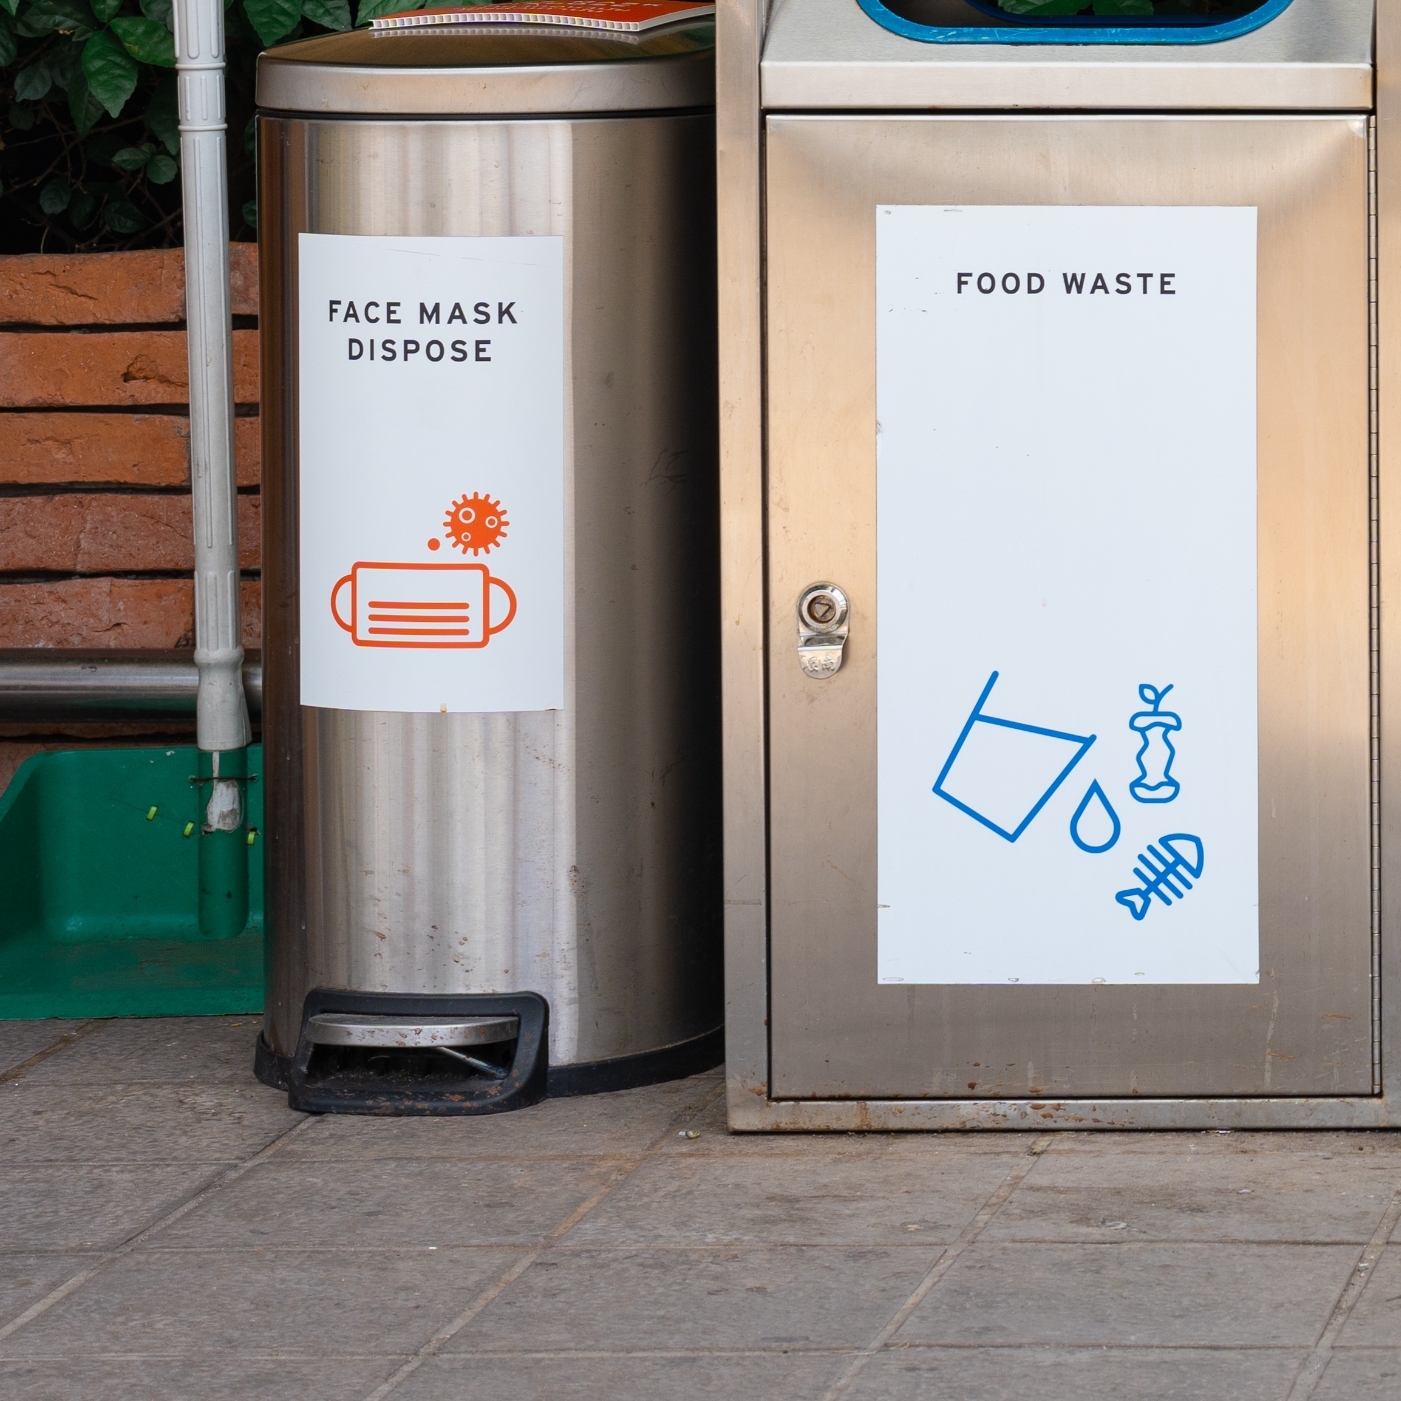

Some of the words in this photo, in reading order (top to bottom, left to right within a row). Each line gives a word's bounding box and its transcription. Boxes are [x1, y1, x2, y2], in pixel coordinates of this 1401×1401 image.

[957, 272, 1045, 295] FOOD
[1062, 272, 1176, 295] WASTE
[329, 299, 402, 324] FACE
[419, 301, 518, 325] MASK
[348, 337, 492, 363] DISPOSE
